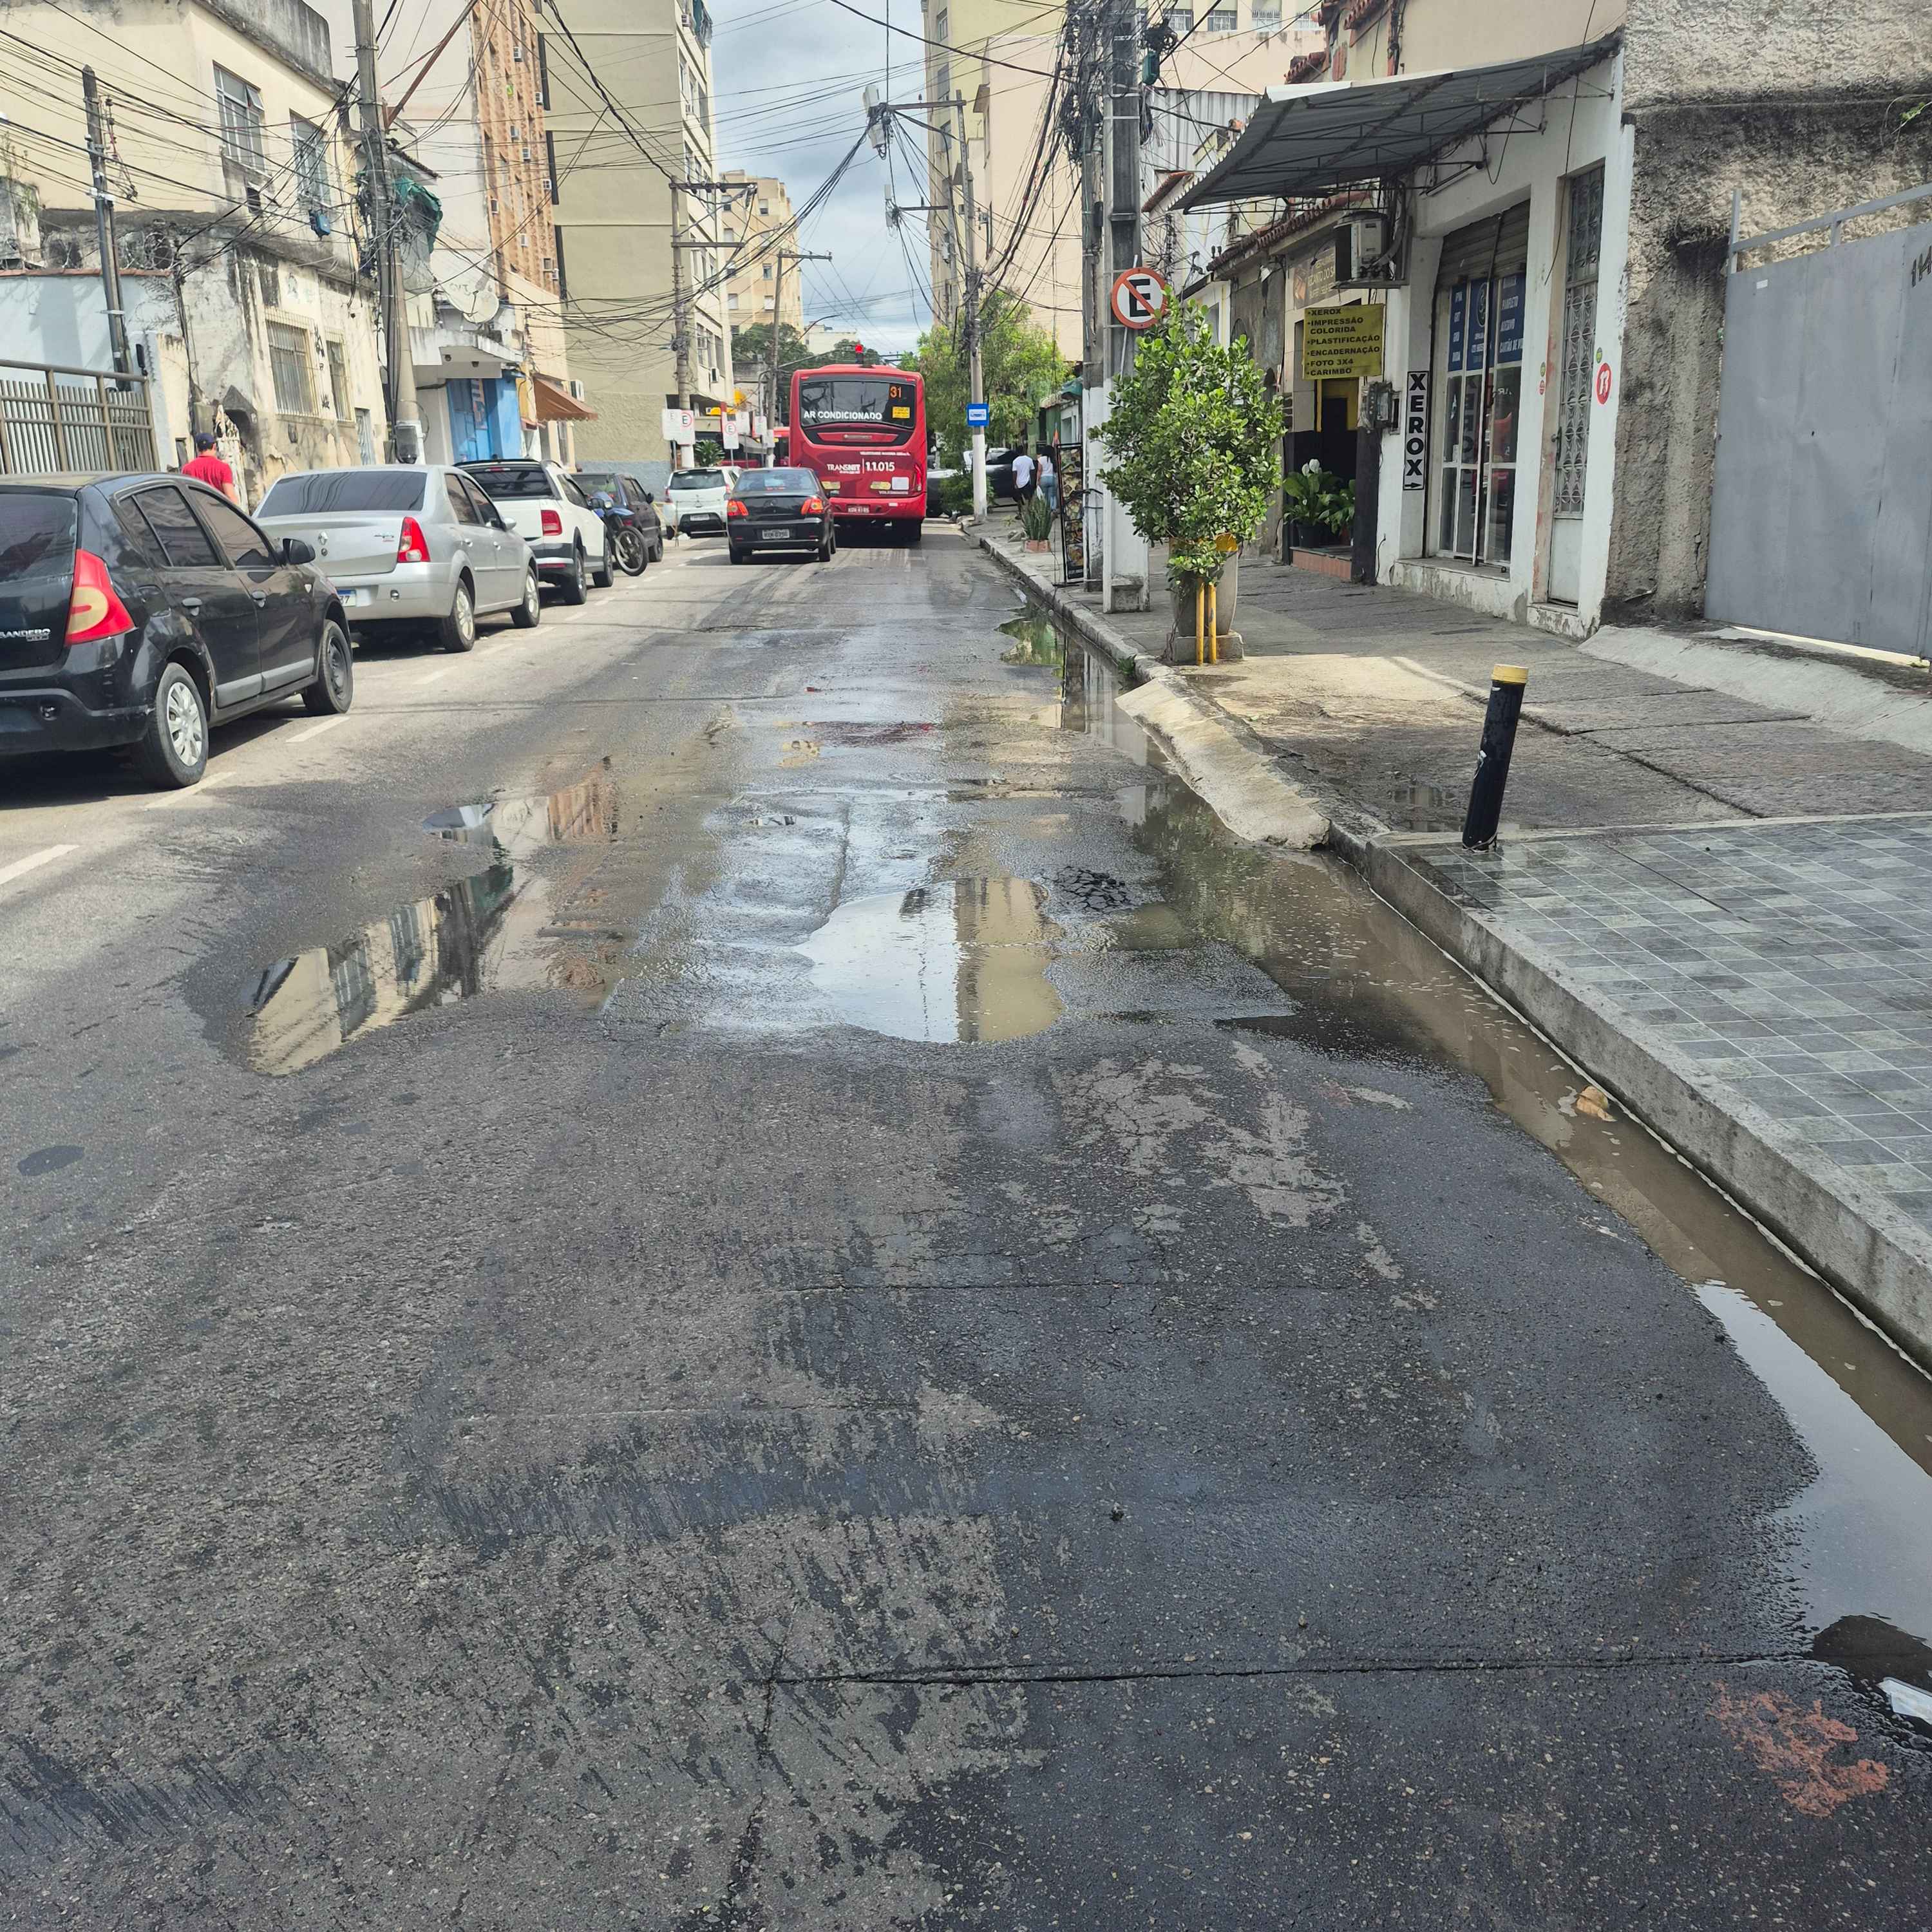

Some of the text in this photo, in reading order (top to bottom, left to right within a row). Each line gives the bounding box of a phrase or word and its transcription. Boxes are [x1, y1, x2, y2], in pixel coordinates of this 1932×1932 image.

[1129, 278, 1151, 317] E
[1311, 308, 1341, 316] XEROX
[1311, 317, 1363, 326] IMPRESSÃO
[1310, 327, 1356, 335] COLORIDA
[1311, 335, 1380, 345] PLASTIFICAÇÃO
[1310, 346, 1380, 357] ENCADERNAÇÃO
[1310, 368, 1352, 376] CARIMBO
[890, 386, 902, 398] 31
[682, 415, 688, 424] E
[817, 411, 882, 420] CONDICIONADO
[1406, 374, 1426, 476] XEROX
[865, 462, 895, 471] 1.1.015
